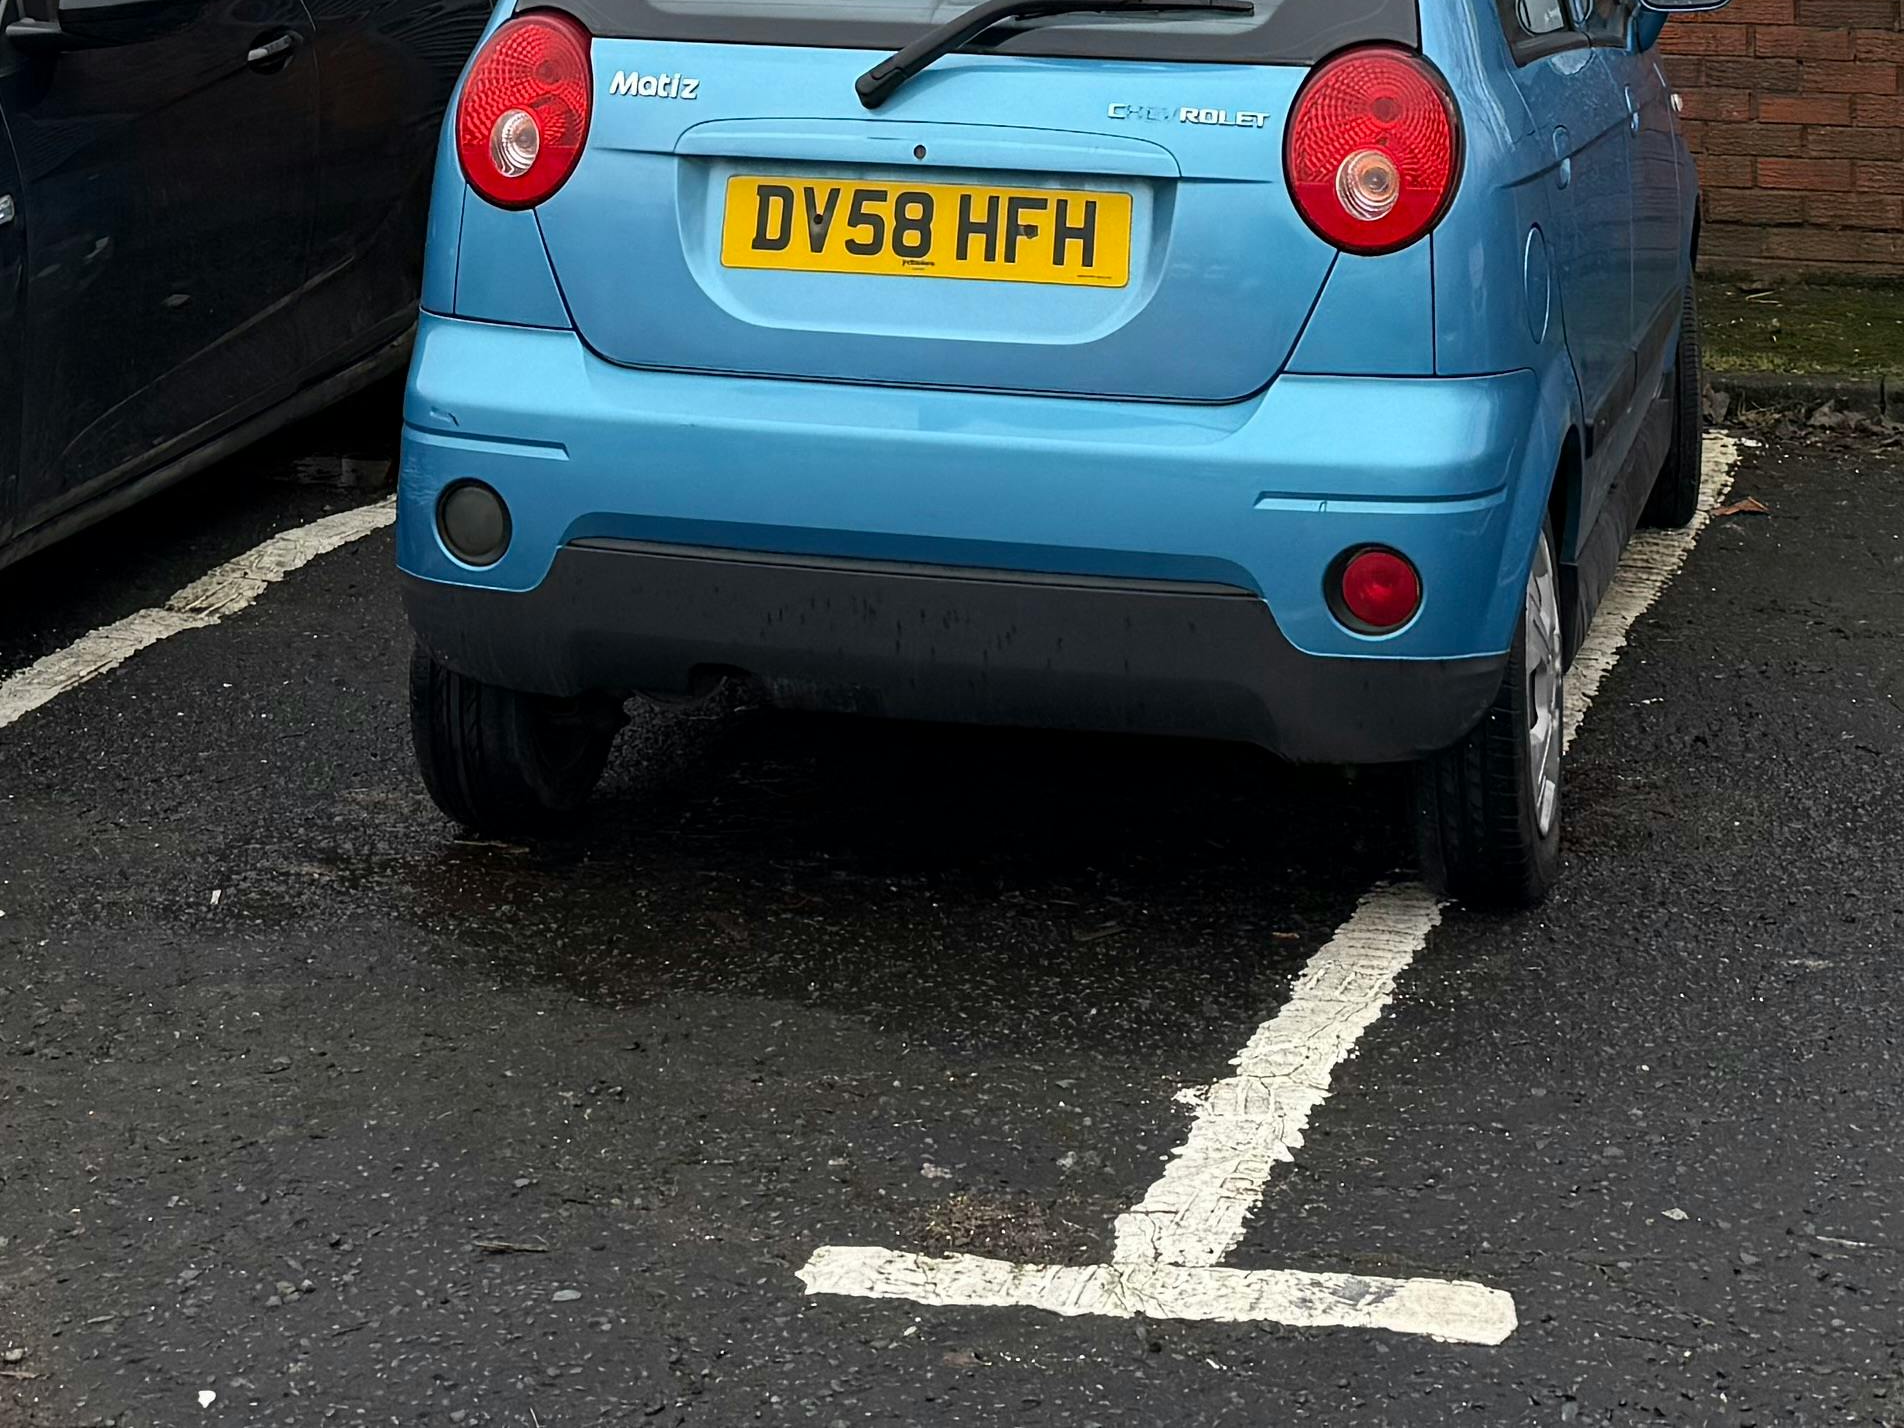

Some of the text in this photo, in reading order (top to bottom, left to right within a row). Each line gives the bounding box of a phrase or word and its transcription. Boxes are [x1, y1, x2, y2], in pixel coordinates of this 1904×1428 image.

[609, 70, 700, 100] Matiz
[751, 184, 936, 259] DV58
[956, 194, 1097, 268] HFH
